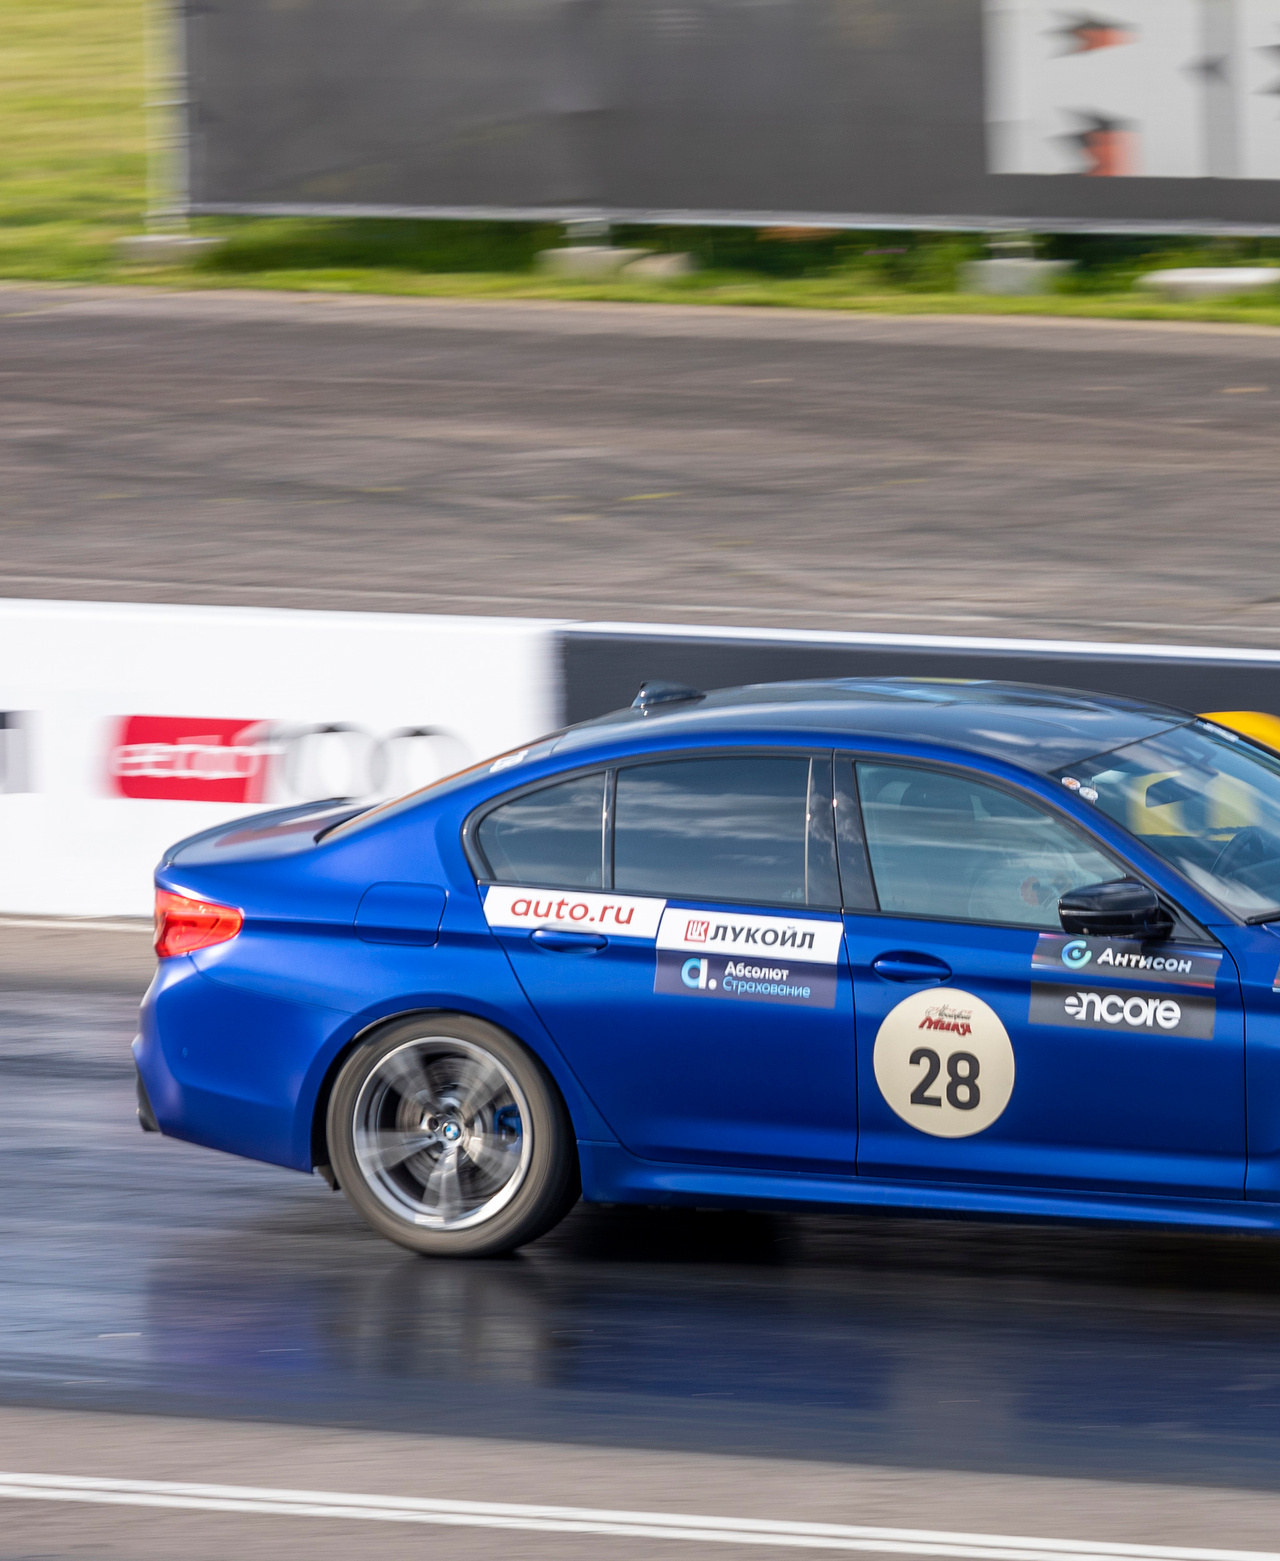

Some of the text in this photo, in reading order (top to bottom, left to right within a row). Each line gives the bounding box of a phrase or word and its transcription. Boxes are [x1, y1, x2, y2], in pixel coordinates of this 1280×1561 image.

[510, 897, 635, 925] auto.ru
[710, 923, 816, 949] ЛУКОЙЛ
[724, 960, 790, 981] Абсолют
[722, 976, 812, 999] Страхование
[1064, 992, 1182, 1030] encore
[908, 1046, 982, 1111] 28
